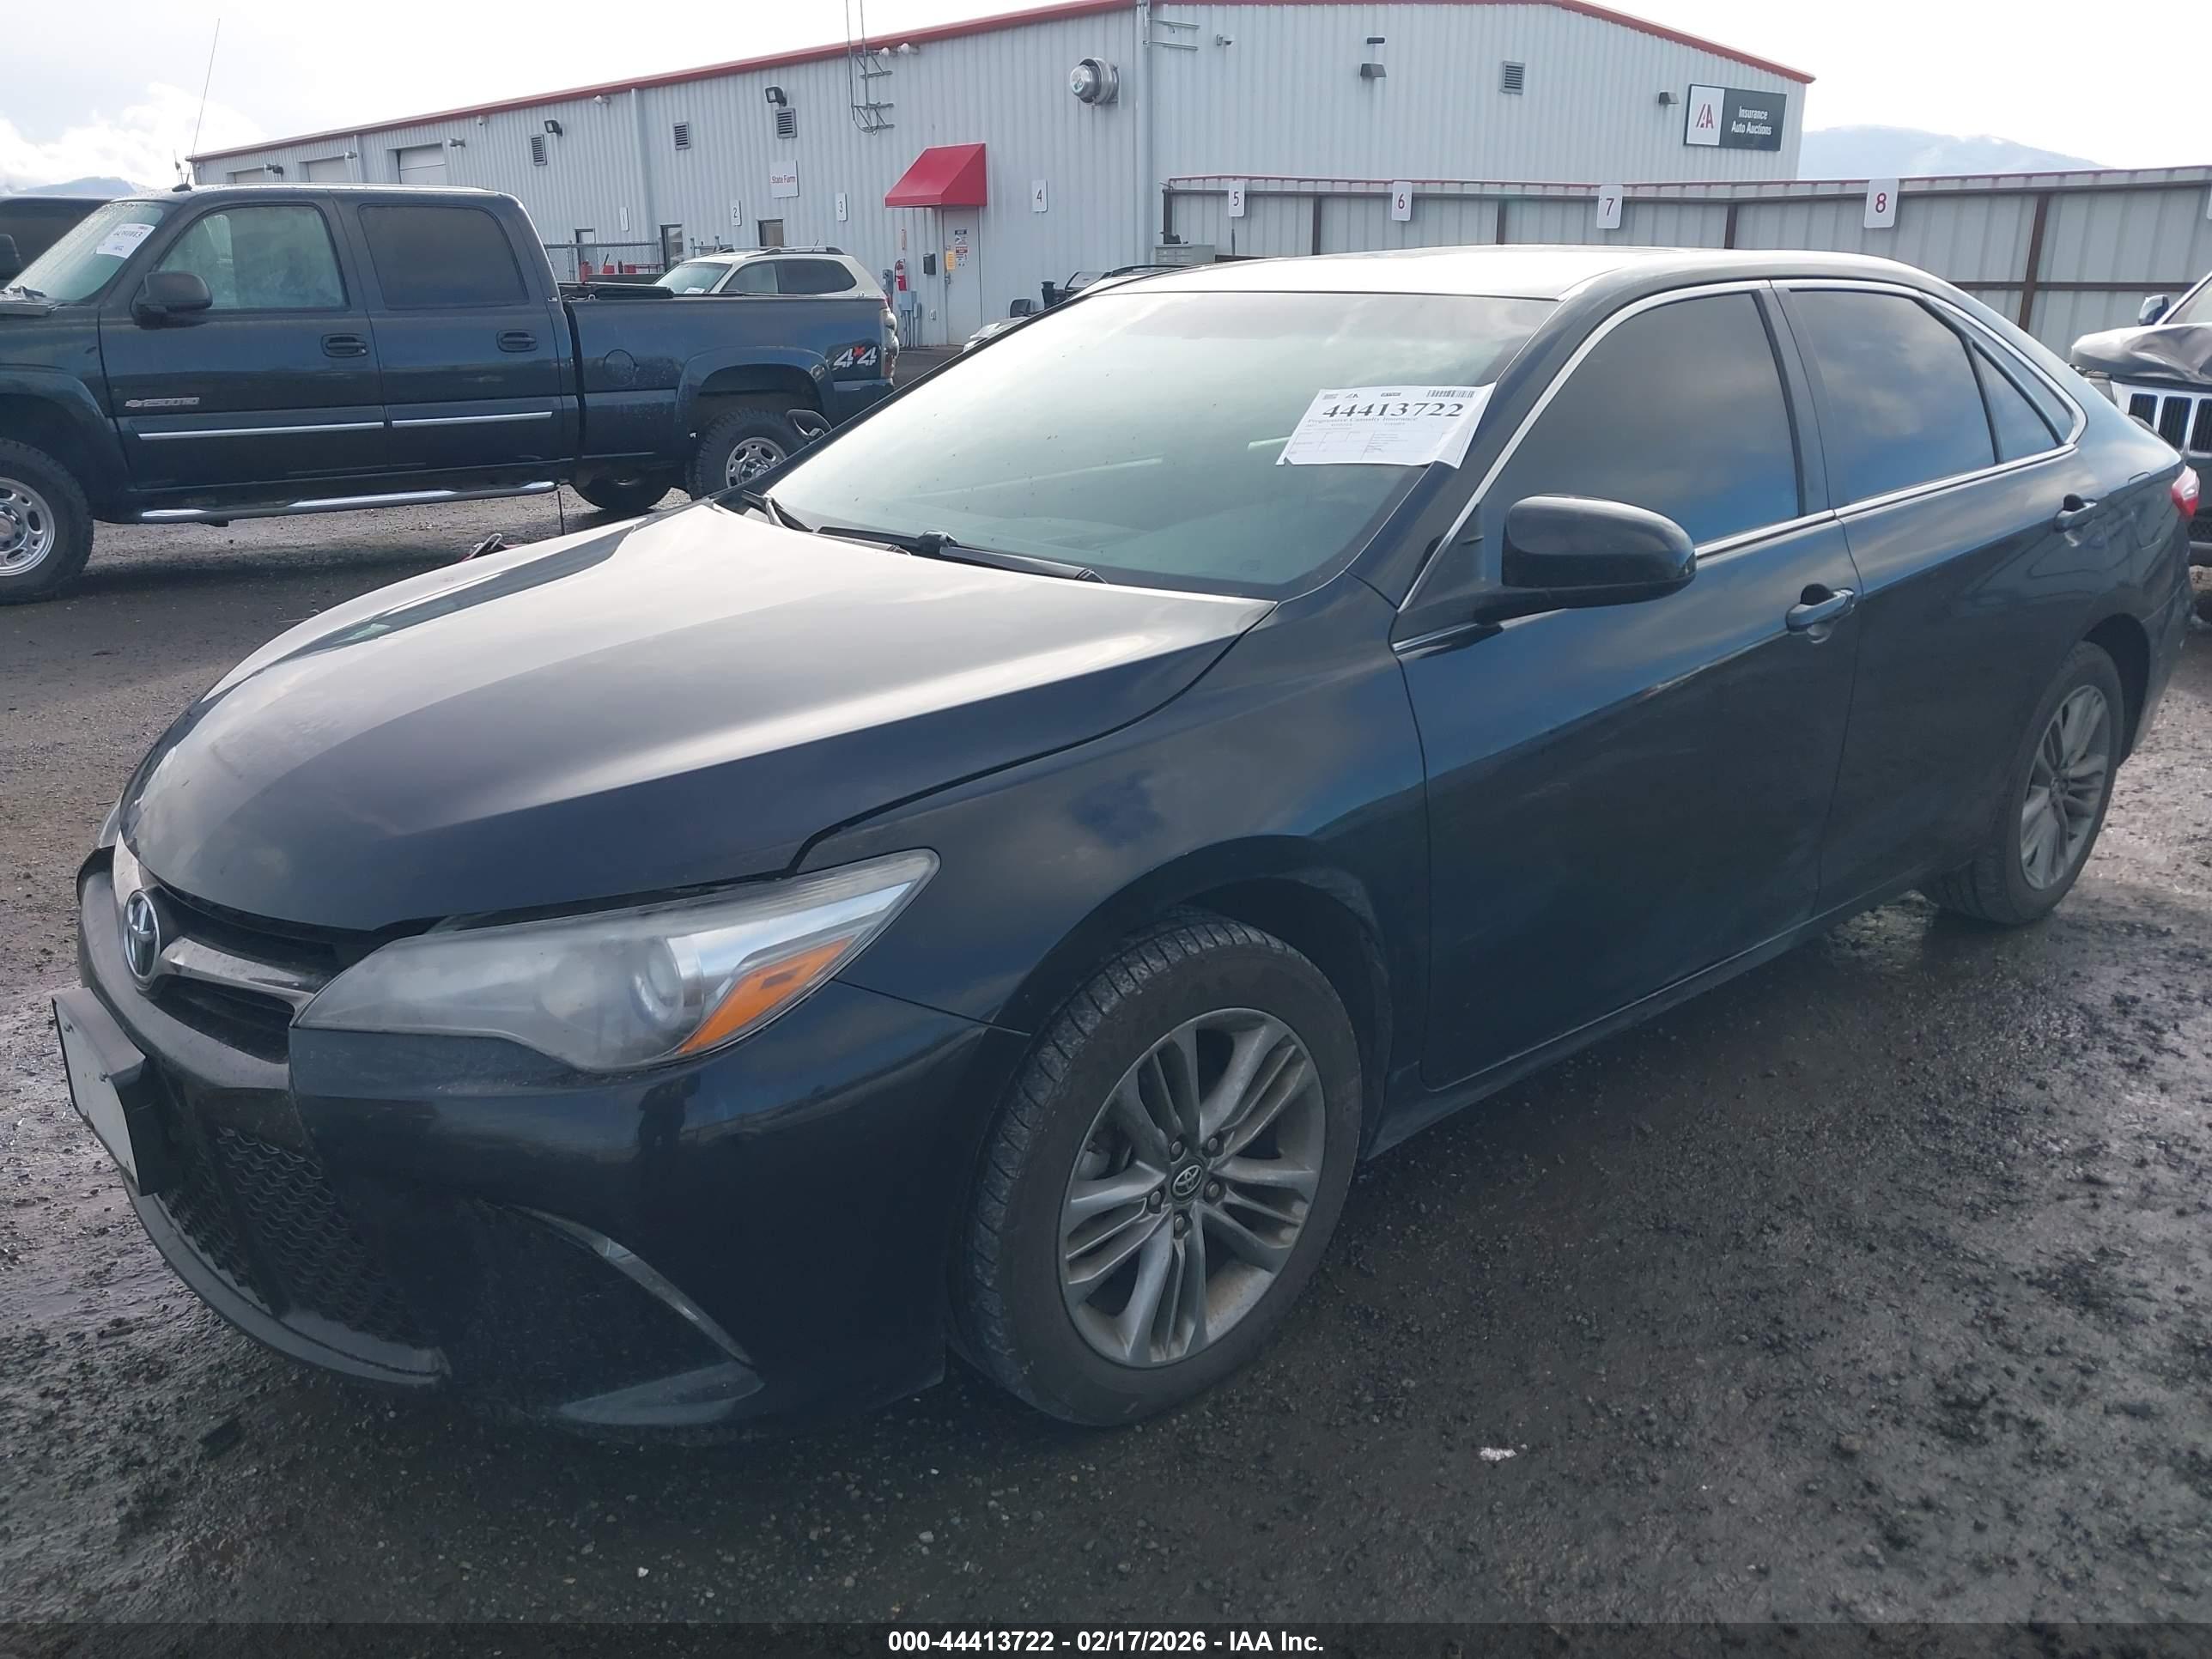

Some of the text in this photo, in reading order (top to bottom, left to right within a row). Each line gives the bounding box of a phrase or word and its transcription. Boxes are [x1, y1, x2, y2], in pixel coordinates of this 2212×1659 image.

[1739, 106, 1768, 119] Insurance
[1731, 120, 1771, 135] Auto Auctions
[783, 175, 796, 184] Farm
[1036, 189, 1042, 203] 4
[1233, 191, 1240, 206] 5
[1397, 193, 1405, 210] 6
[1875, 192, 1887, 214] 8
[732, 207, 738, 218] 2
[839, 201, 843, 213] 3
[1606, 198, 1615, 216] 7
[1322, 402, 1464, 418] 44413722
